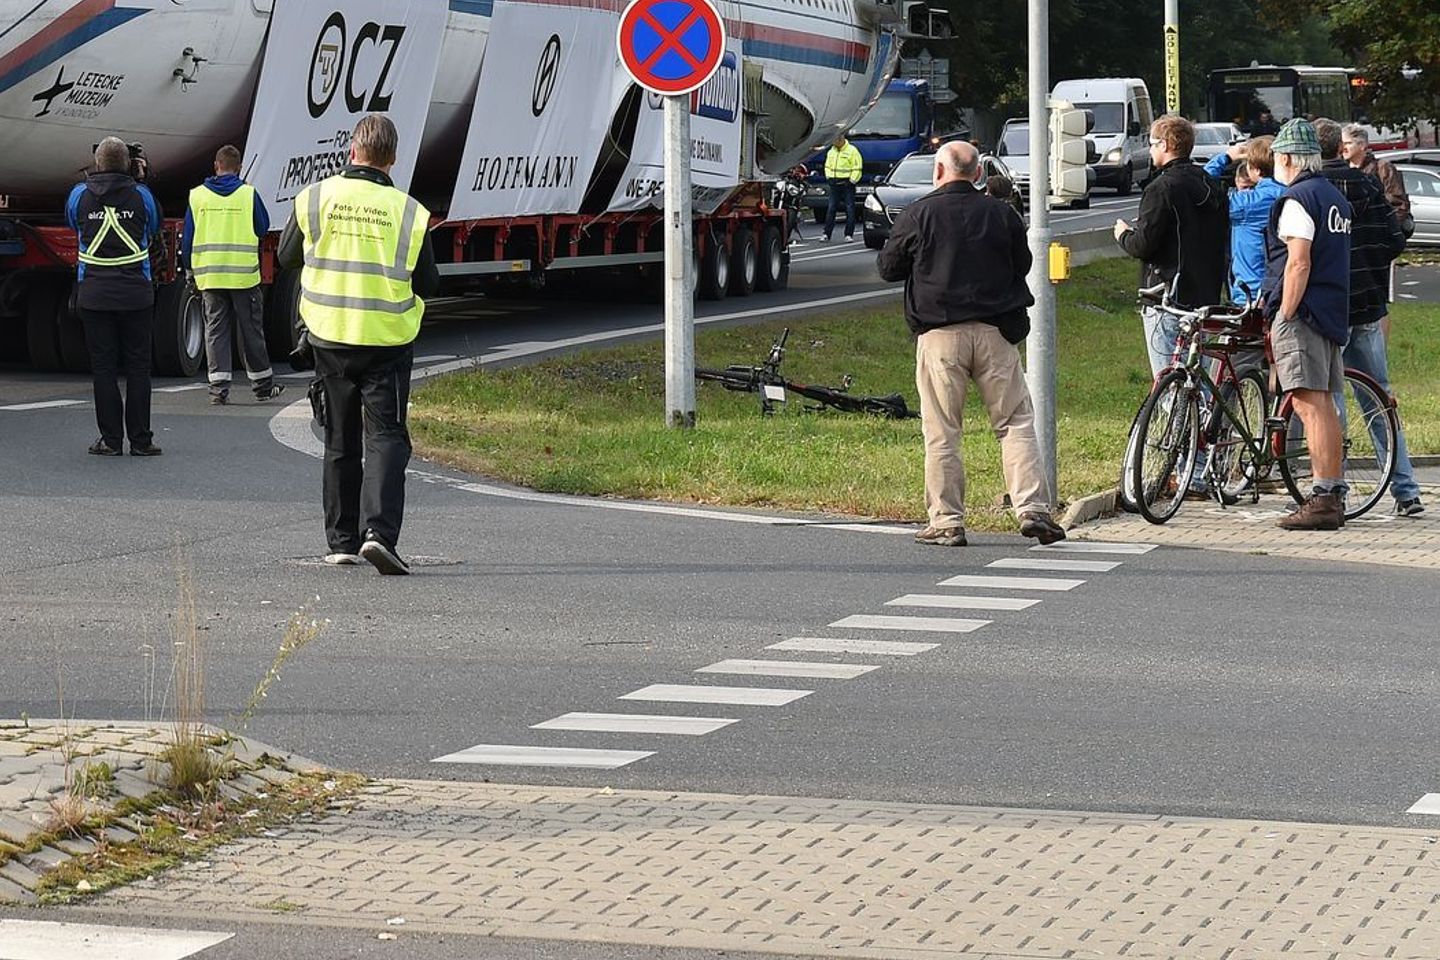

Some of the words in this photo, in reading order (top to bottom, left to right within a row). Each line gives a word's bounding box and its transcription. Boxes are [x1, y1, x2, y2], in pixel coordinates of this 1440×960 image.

[63, 89, 115, 108] MUZEUM
[471, 155, 579, 192] HOFFMANN
[87, 209, 135, 220] airZe.TV
[332, 202, 354, 212] Foto
[362, 205, 389, 217] Video
[326, 212, 393, 228] Dokumentation
